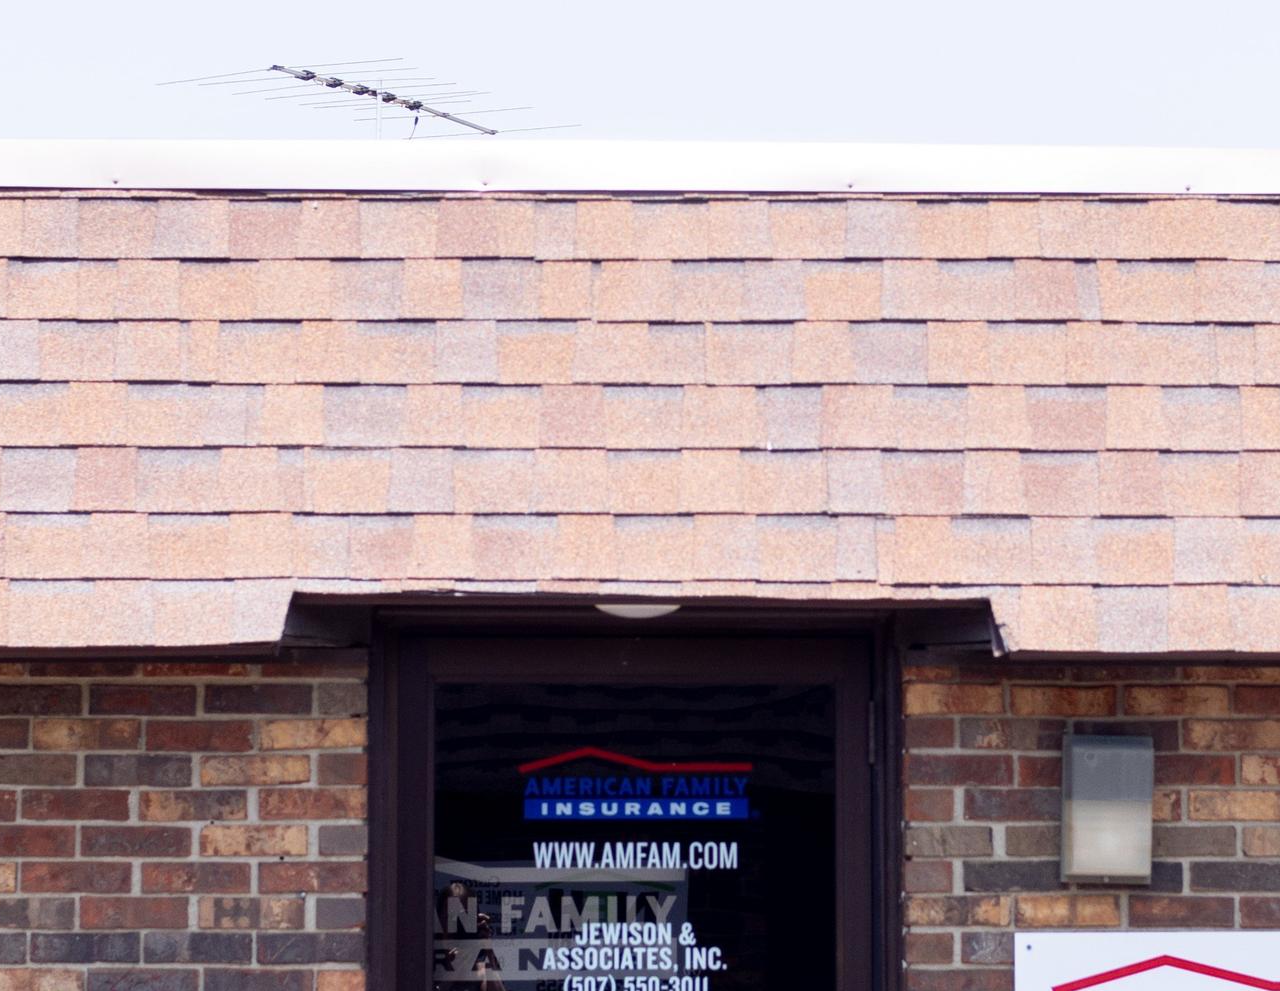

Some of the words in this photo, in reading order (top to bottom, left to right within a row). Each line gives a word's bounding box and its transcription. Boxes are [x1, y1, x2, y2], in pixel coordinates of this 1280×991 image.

[524, 777, 653, 796] AMERICAN
[661, 777, 749, 796] FAMILY
[542, 802, 730, 815] INSURANCE
[534, 843, 736, 869] WWW.AMFAM.COM
[576, 923, 671, 945] JEWISON
[679, 923, 695, 945] &
[543, 947, 677, 971] ASSOCIATES,
[686, 948, 726, 969] INC.
